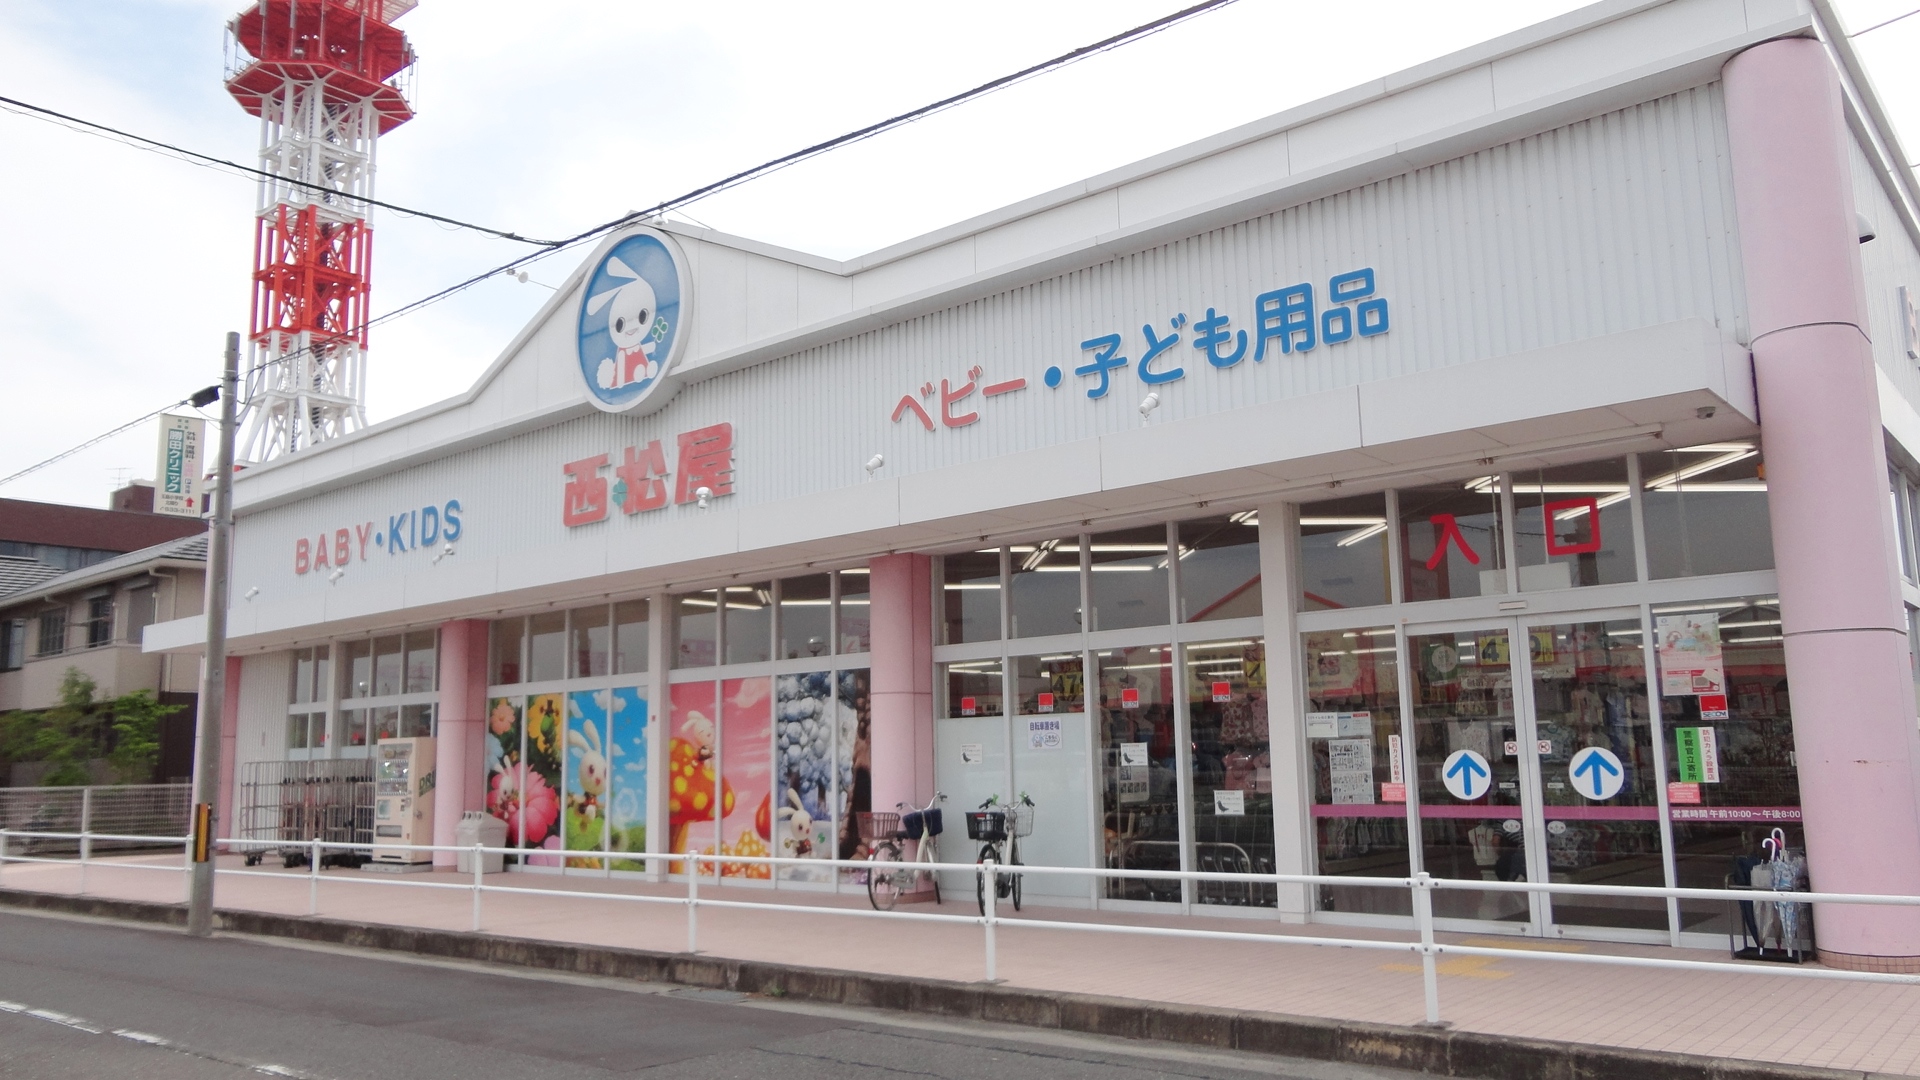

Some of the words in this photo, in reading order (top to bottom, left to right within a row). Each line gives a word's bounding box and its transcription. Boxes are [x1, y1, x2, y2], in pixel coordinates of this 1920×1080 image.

[891, 267, 1390, 431] ベビー・子ども用品
[562, 421, 736, 528] 西松屋
[1426, 497, 1601, 570] 入口
